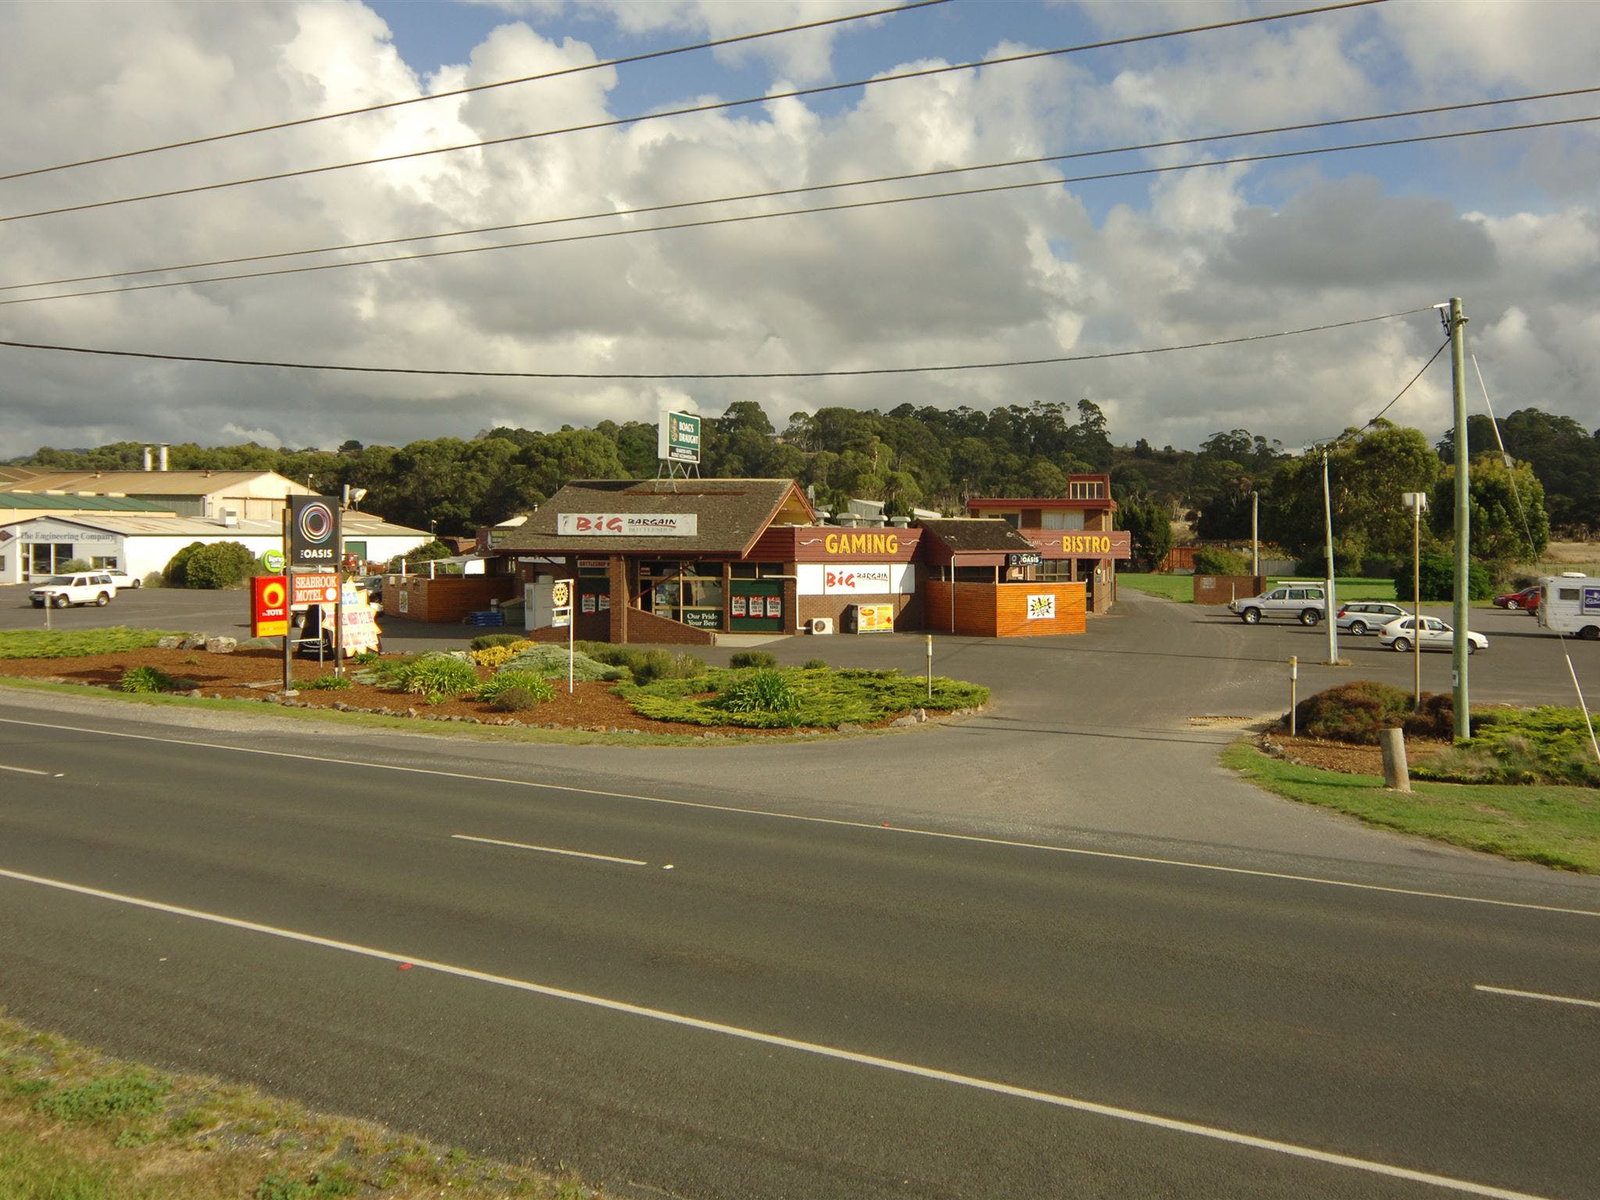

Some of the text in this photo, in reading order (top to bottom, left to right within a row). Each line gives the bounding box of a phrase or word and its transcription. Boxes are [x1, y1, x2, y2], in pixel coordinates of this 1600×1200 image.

[628, 518, 677, 526] BARGAIN
[20, 532, 115, 542] The Engineering Company
[825, 533, 898, 554] GAMING
[304, 549, 333, 558] OASIS
[295, 576, 337, 588] SEABROOK
[295, 589, 324, 602] MOTEL
[702, 612, 718, 620] Pride
